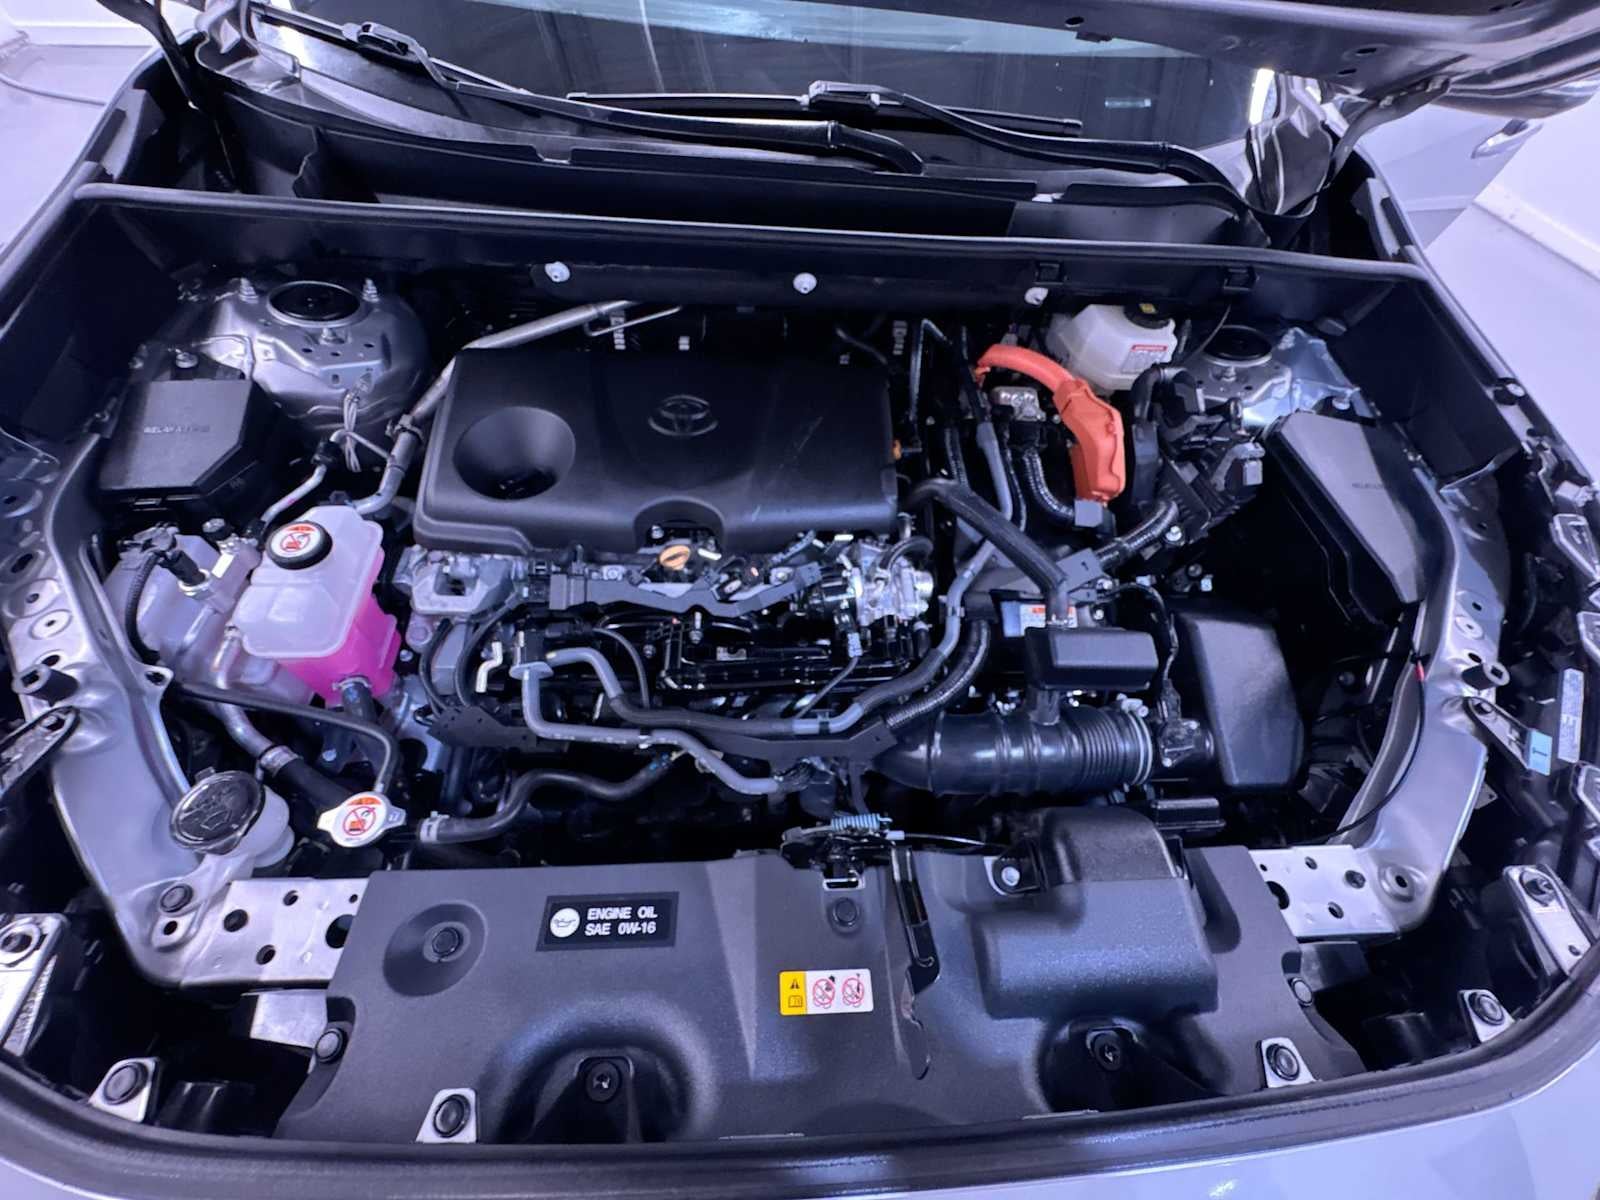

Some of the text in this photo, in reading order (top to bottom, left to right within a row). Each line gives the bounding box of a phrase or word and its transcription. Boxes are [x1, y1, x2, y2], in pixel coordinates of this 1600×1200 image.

[587, 905, 658, 921] ENGINE OIL
[584, 921, 657, 937] SAE 0W-16
